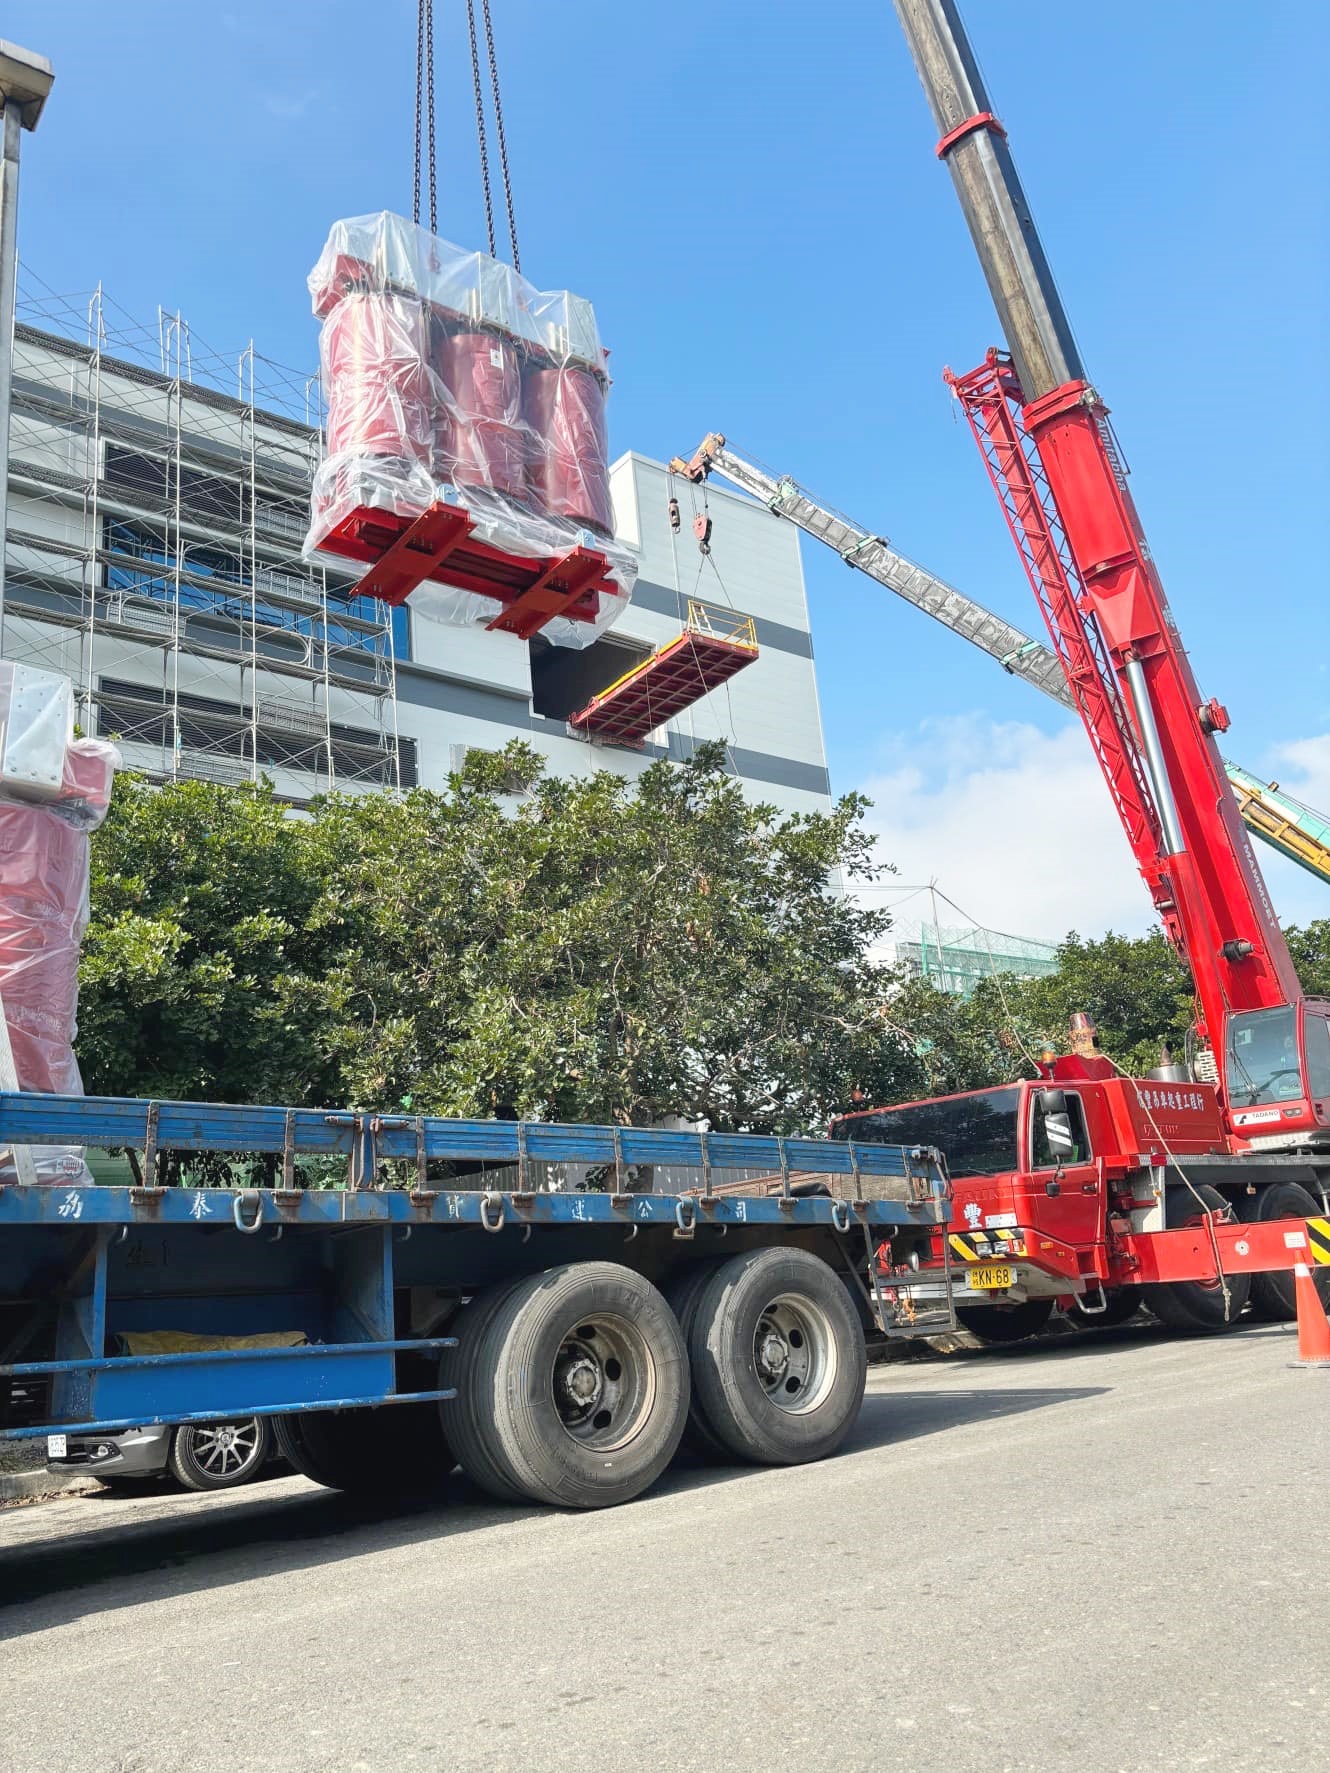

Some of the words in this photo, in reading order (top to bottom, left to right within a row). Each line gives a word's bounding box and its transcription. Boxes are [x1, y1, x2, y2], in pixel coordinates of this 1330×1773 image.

[1096, 418, 1127, 490] Amitabha
[1243, 844, 1277, 929] MAMMOET
[1251, 1110, 1279, 1118] TADANO
[978, 1268, 1009, 1286] KN-68
